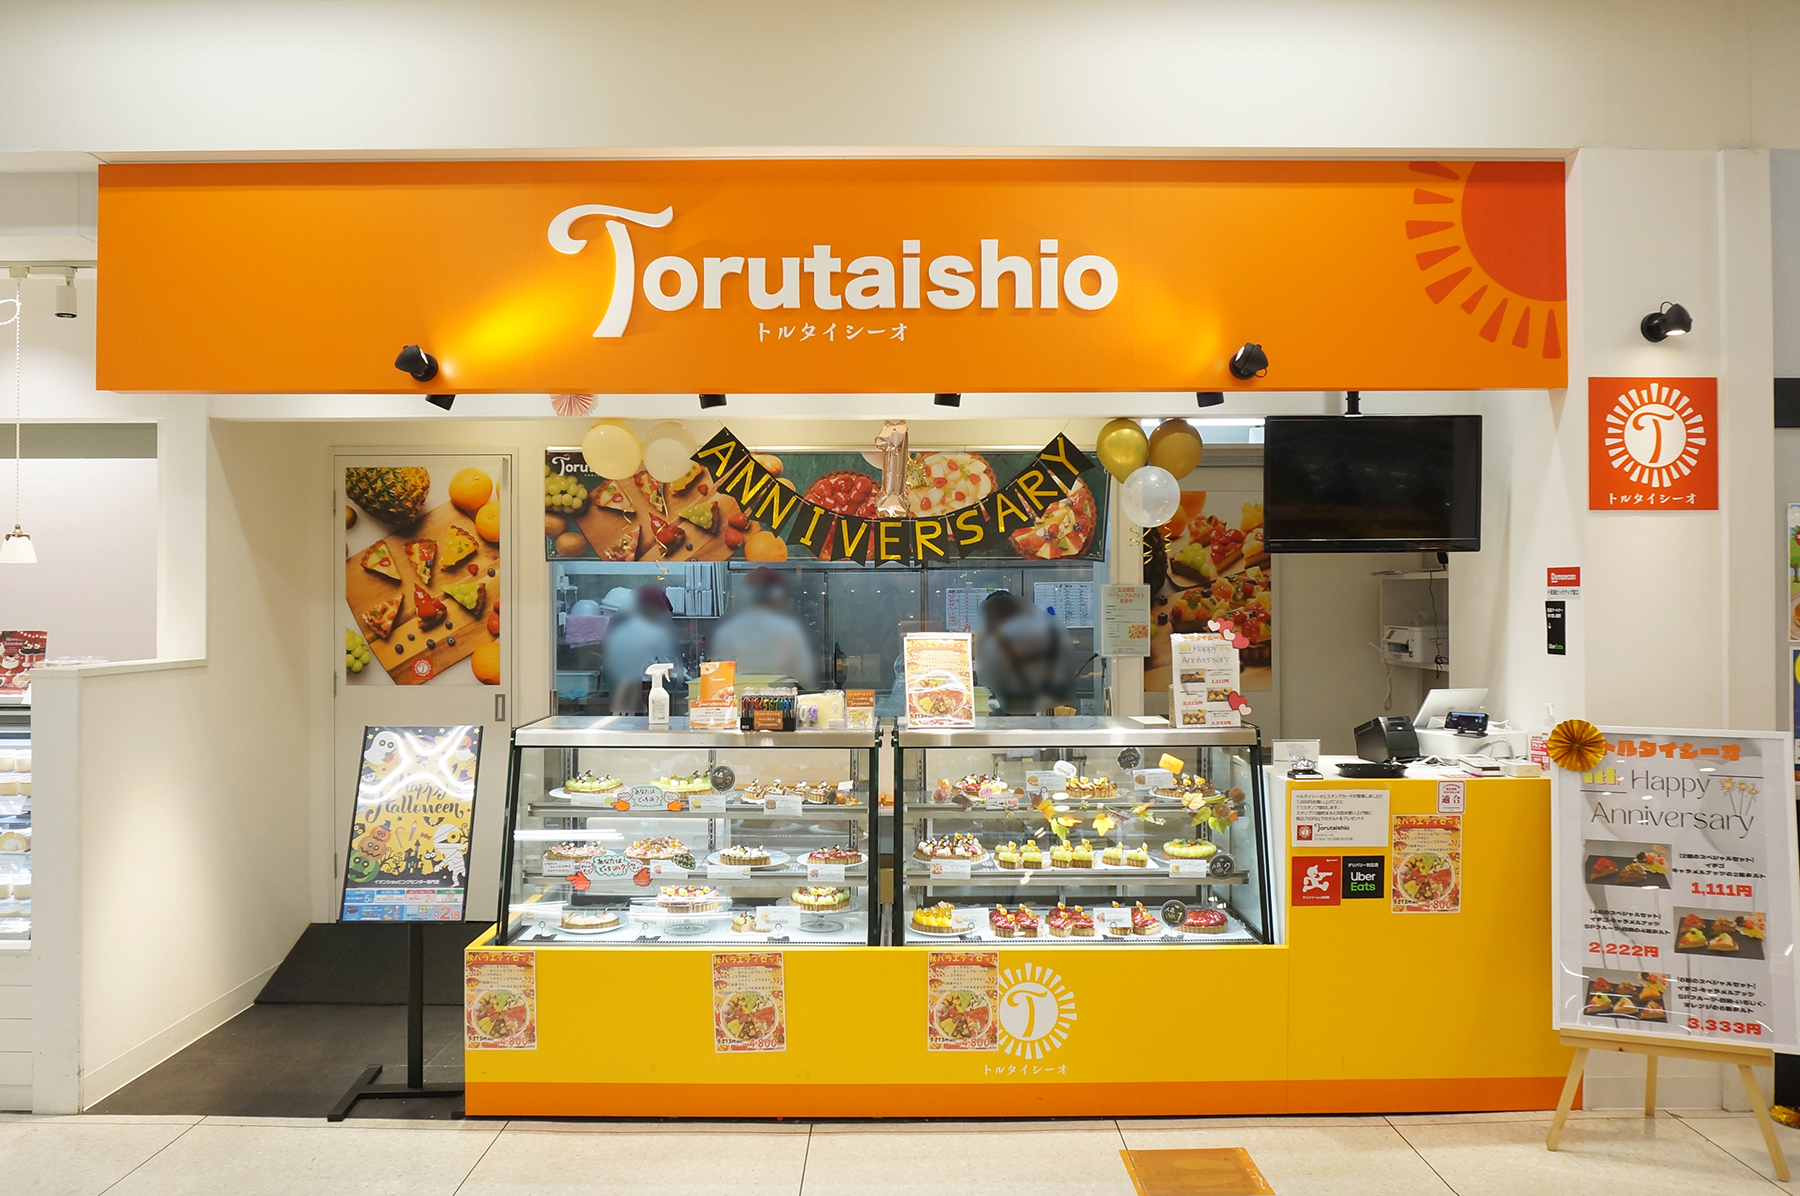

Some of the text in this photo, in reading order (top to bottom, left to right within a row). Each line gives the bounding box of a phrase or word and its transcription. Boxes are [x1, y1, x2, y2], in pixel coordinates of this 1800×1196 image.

[547, 204, 1119, 338] Torutaishio
[757, 322, 908, 343] トルタイシーオ
[697, 438, 1081, 560] ANNIVERSARY
[1609, 493, 1697, 505] トルタイシーオ
[1193, 645, 1217, 654] Happy
[1182, 656, 1230, 665] Anniversary
[1631, 769, 1711, 799] Happy
[1314, 823, 1350, 832] Torutaishio
[1591, 801, 1755, 839] Anniversary
[1350, 871, 1376, 881] Uber
[1350, 882, 1376, 891] Eats
[1691, 882, 1753, 897] 1,111円
[1589, 941, 1659, 958] 2,222円
[1687, 1017, 1762, 1035] 3,333円
[984, 1064, 1067, 1076] トルタイシーオ
